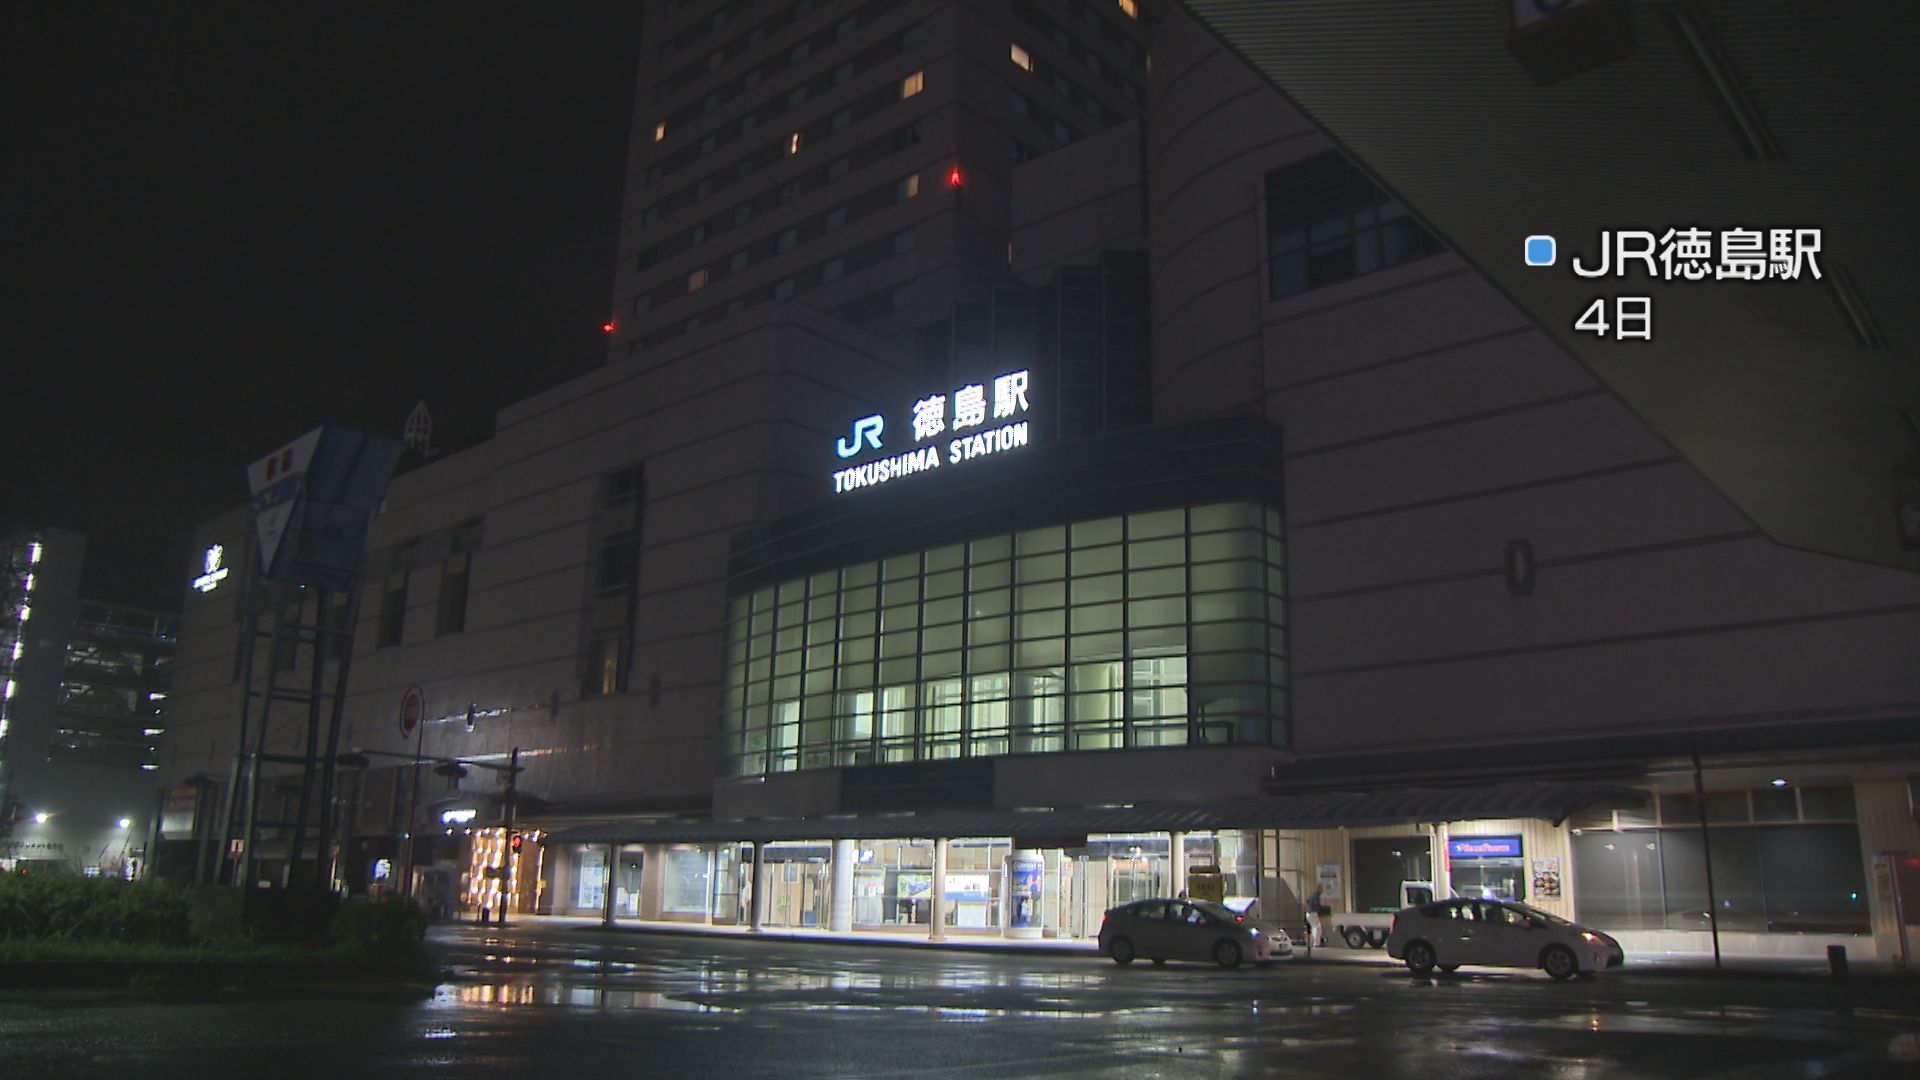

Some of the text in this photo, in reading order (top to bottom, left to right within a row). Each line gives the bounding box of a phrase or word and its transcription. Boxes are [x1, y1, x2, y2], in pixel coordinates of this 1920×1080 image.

[836, 369, 1030, 459] JR 徳島駅
[832, 421, 1029, 494] TOKUSHIMA STATION
